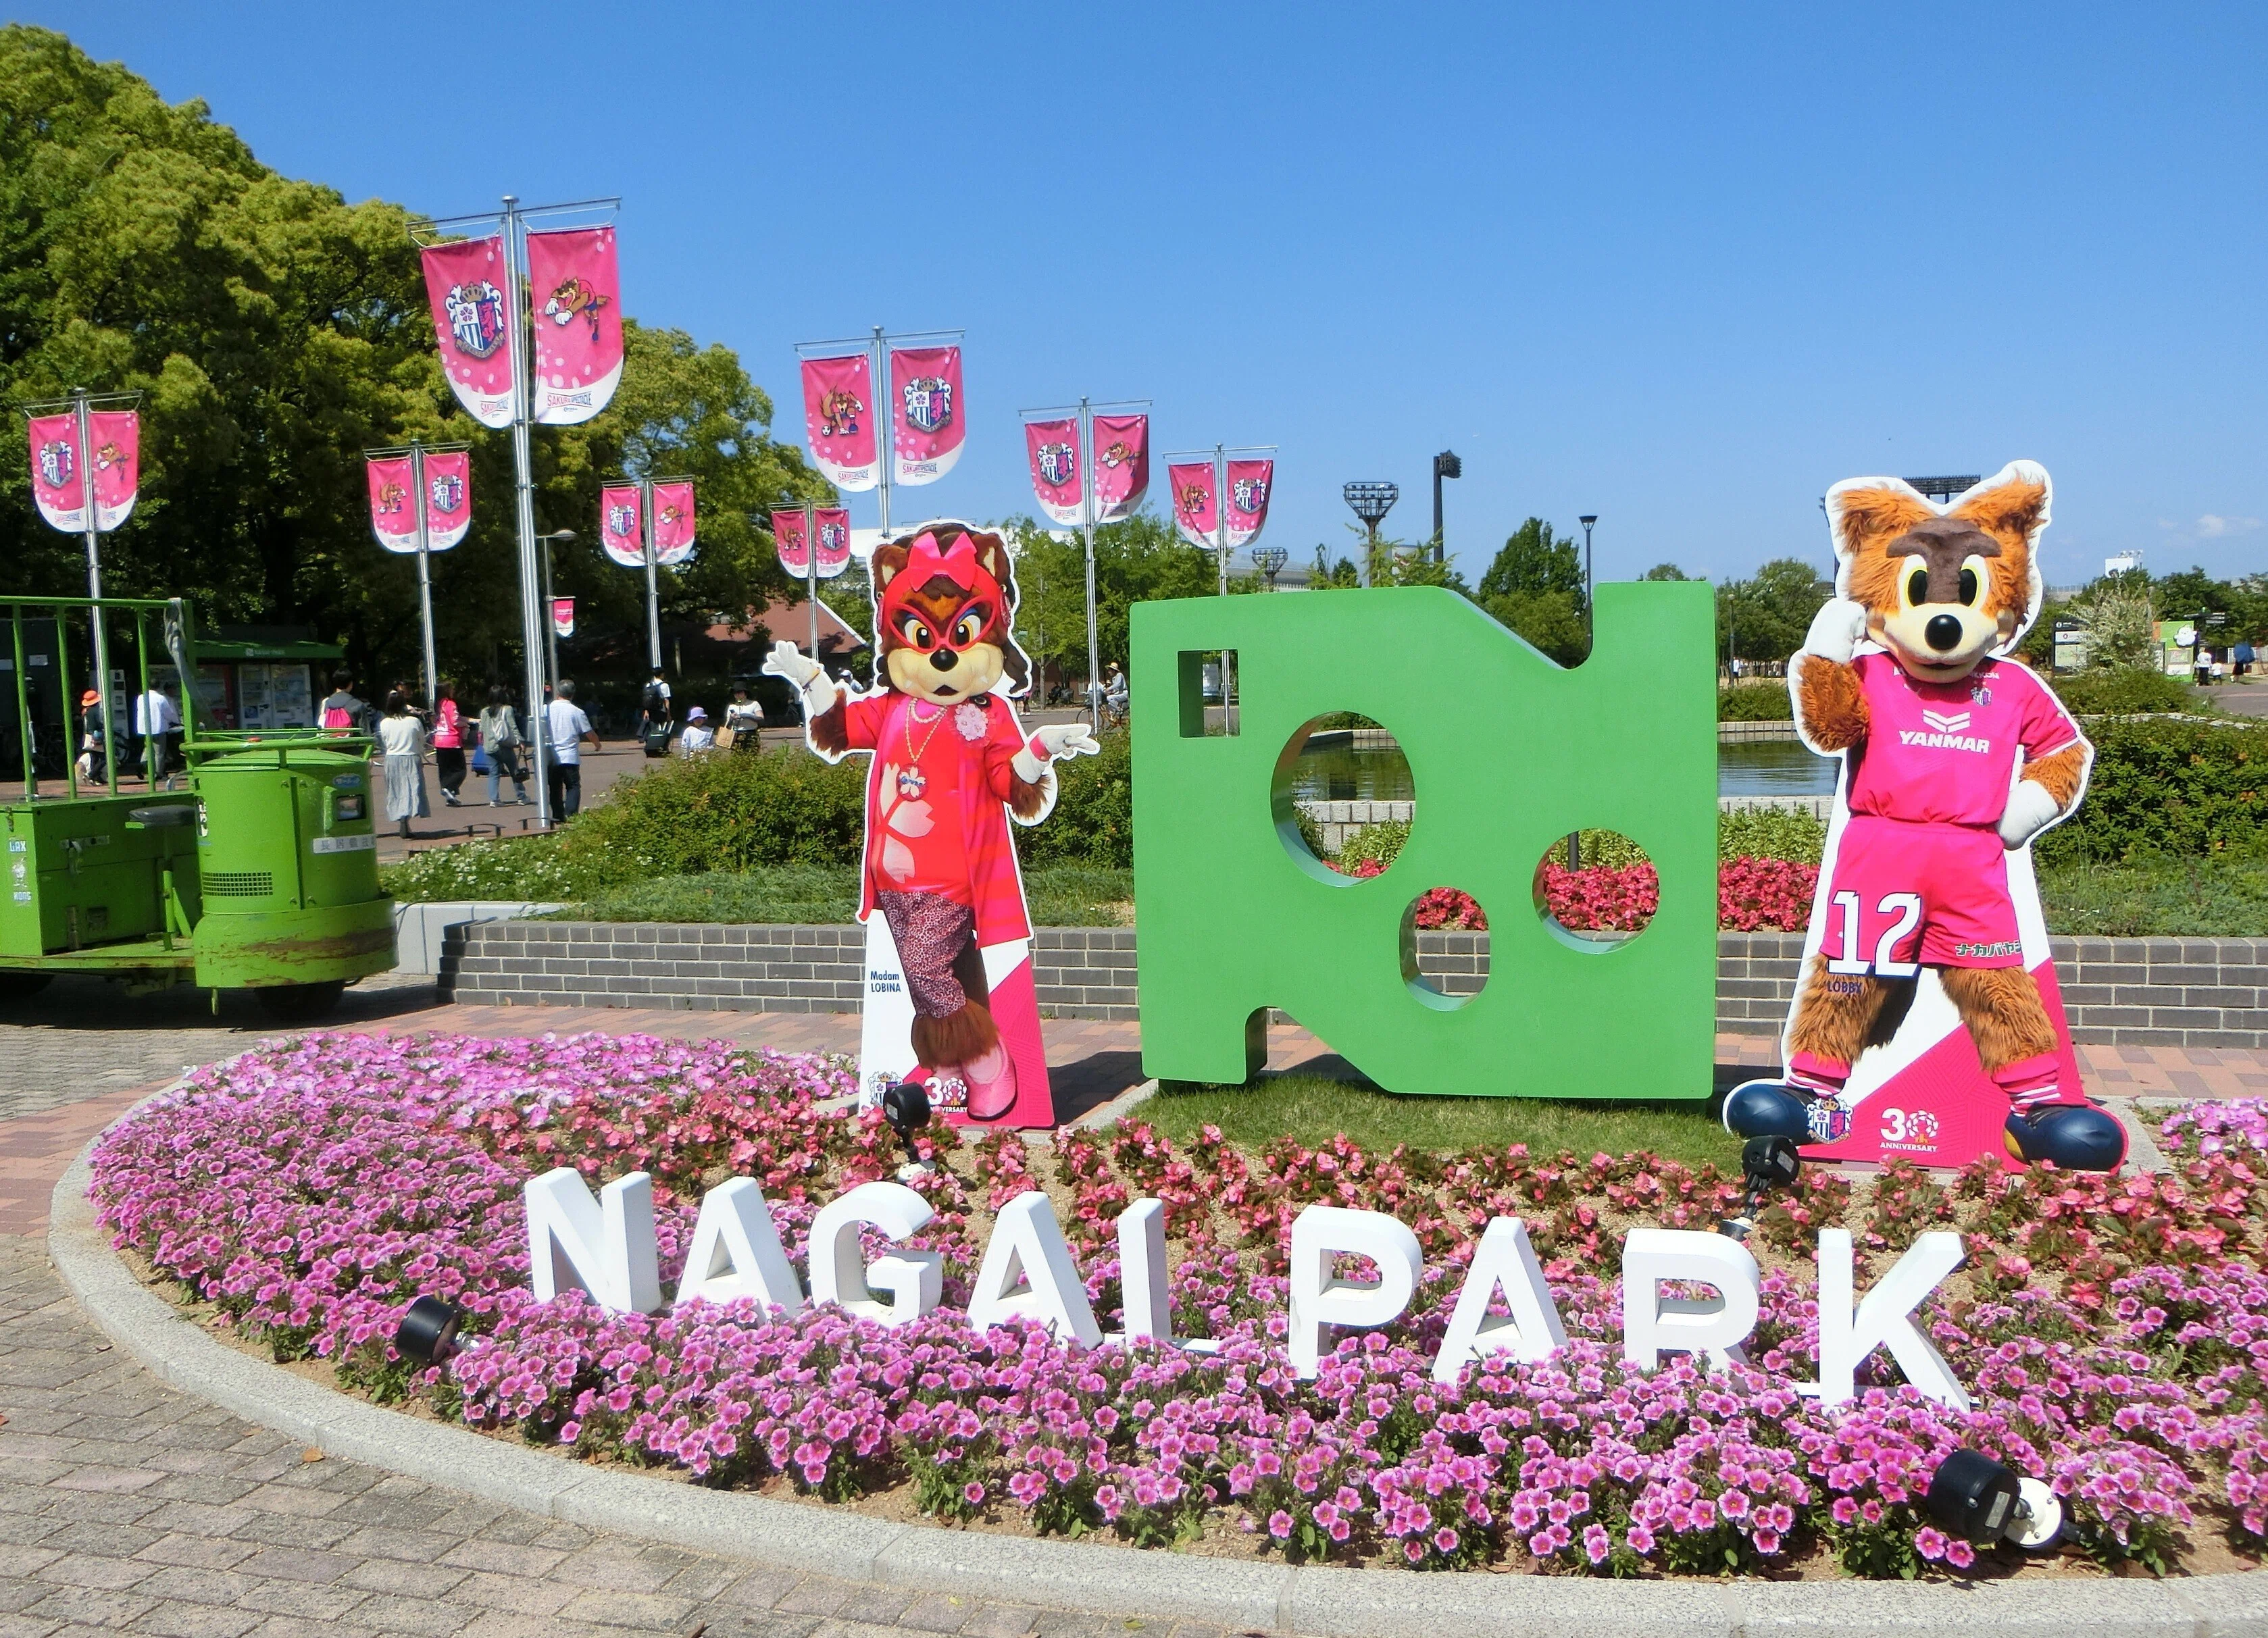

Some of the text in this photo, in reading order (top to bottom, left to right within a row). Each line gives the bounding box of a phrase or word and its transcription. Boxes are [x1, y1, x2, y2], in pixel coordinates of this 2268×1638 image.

[547, 394, 570, 407] SAKURA
[1898, 730, 1990, 754] YANMAR
[1828, 890, 1921, 977] 12
[871, 970, 899, 980] Madam
[872, 983, 901, 992] LOBINA
[1828, 981, 1862, 994] LOBBY
[1880, 1142, 1938, 1152] ANNIVERSARY
[525, 1167, 1971, 1414] NAGAI PARK
